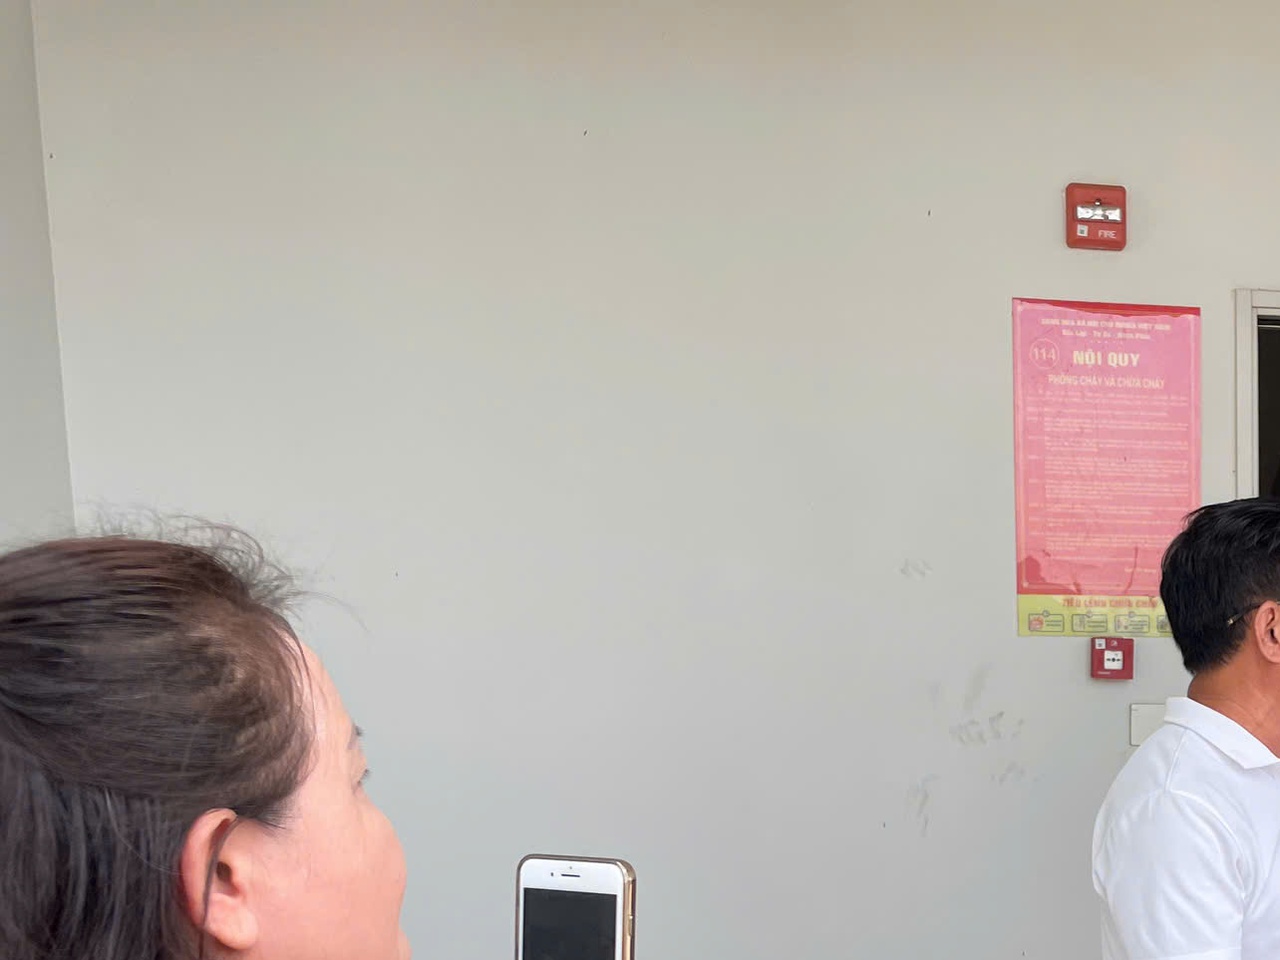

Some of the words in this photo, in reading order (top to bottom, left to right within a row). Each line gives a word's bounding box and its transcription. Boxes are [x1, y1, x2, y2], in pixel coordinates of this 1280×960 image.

[1098, 229, 1117, 239] FIRE
[1032, 347, 1056, 361] 114
[1073, 349, 1102, 367] NỘI
